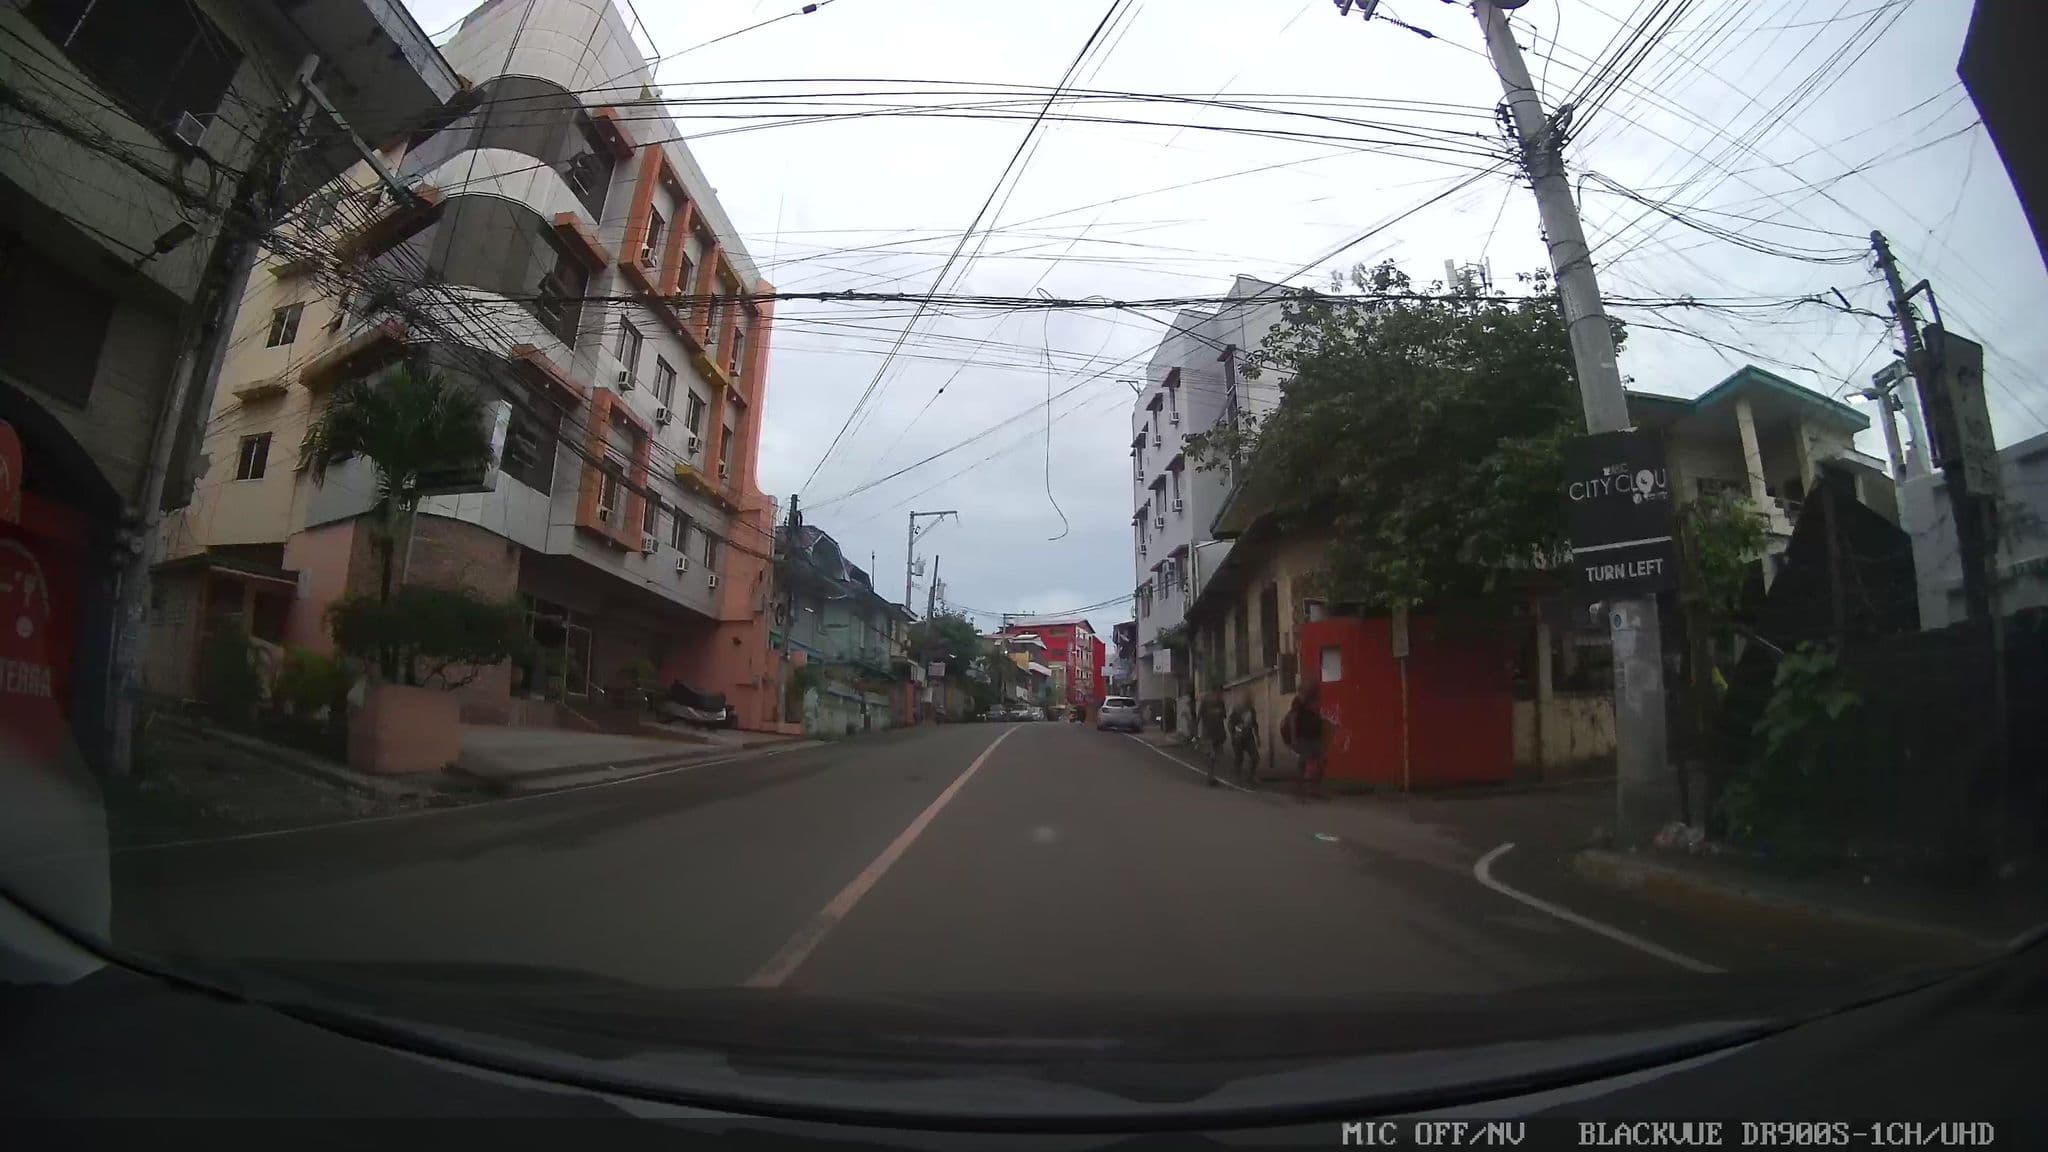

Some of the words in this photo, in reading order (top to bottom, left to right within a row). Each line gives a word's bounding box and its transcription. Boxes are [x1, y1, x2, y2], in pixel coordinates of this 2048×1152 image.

[1569, 476, 1611, 501] CITY
[1585, 562, 1625, 582] TURN
[1628, 558, 1664, 578] LEFT
